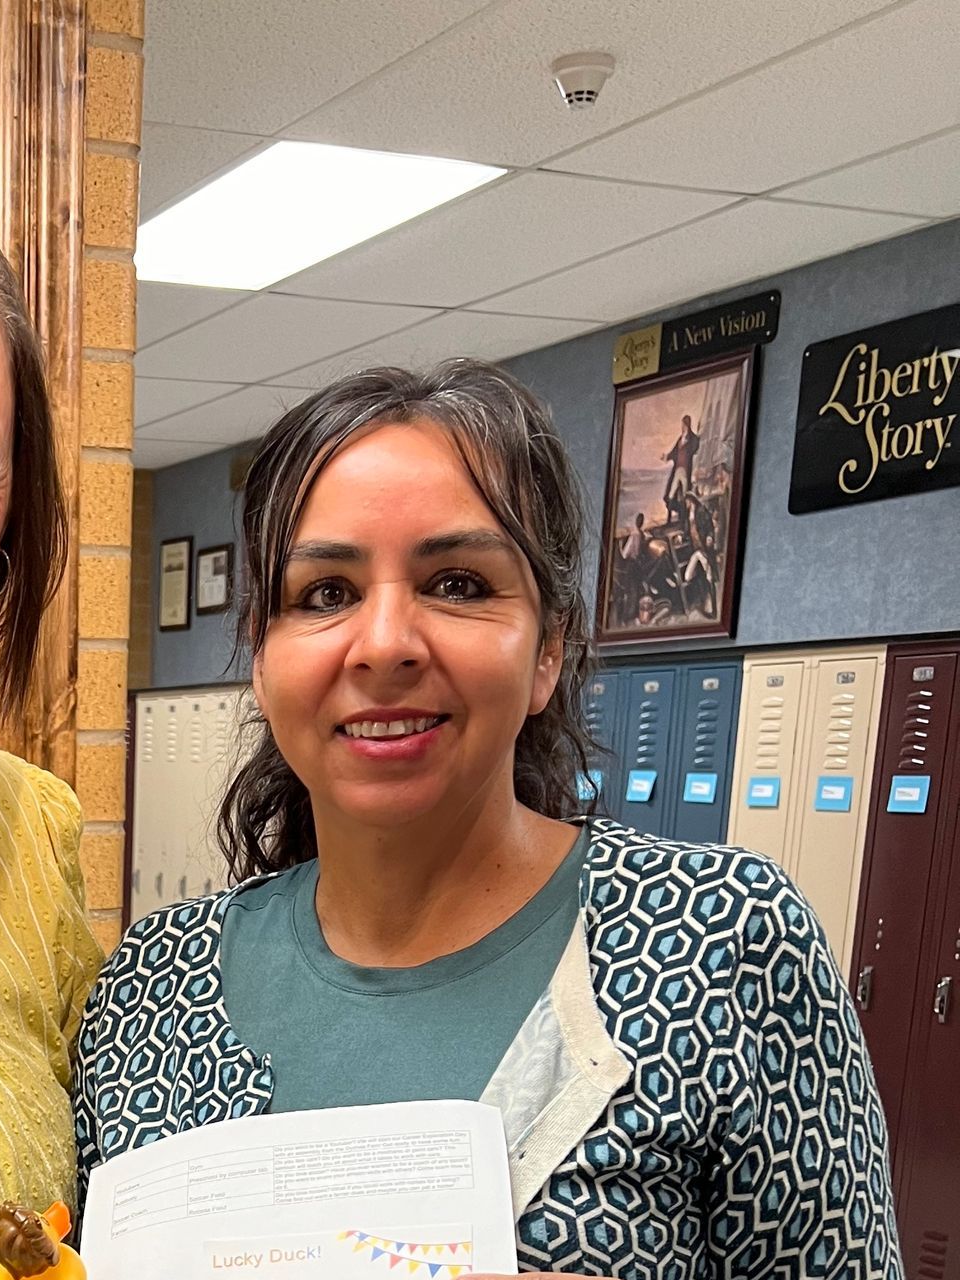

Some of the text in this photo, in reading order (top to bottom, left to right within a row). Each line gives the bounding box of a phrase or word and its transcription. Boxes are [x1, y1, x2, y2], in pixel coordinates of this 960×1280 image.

[669, 331, 678, 353] A
[685, 325, 715, 350] New
[719, 310, 766, 337] Vision
[819, 343, 960, 425] Liberty
[839, 402, 957, 494] Story
[212, 1246, 321, 1269] Lucky Duck!
